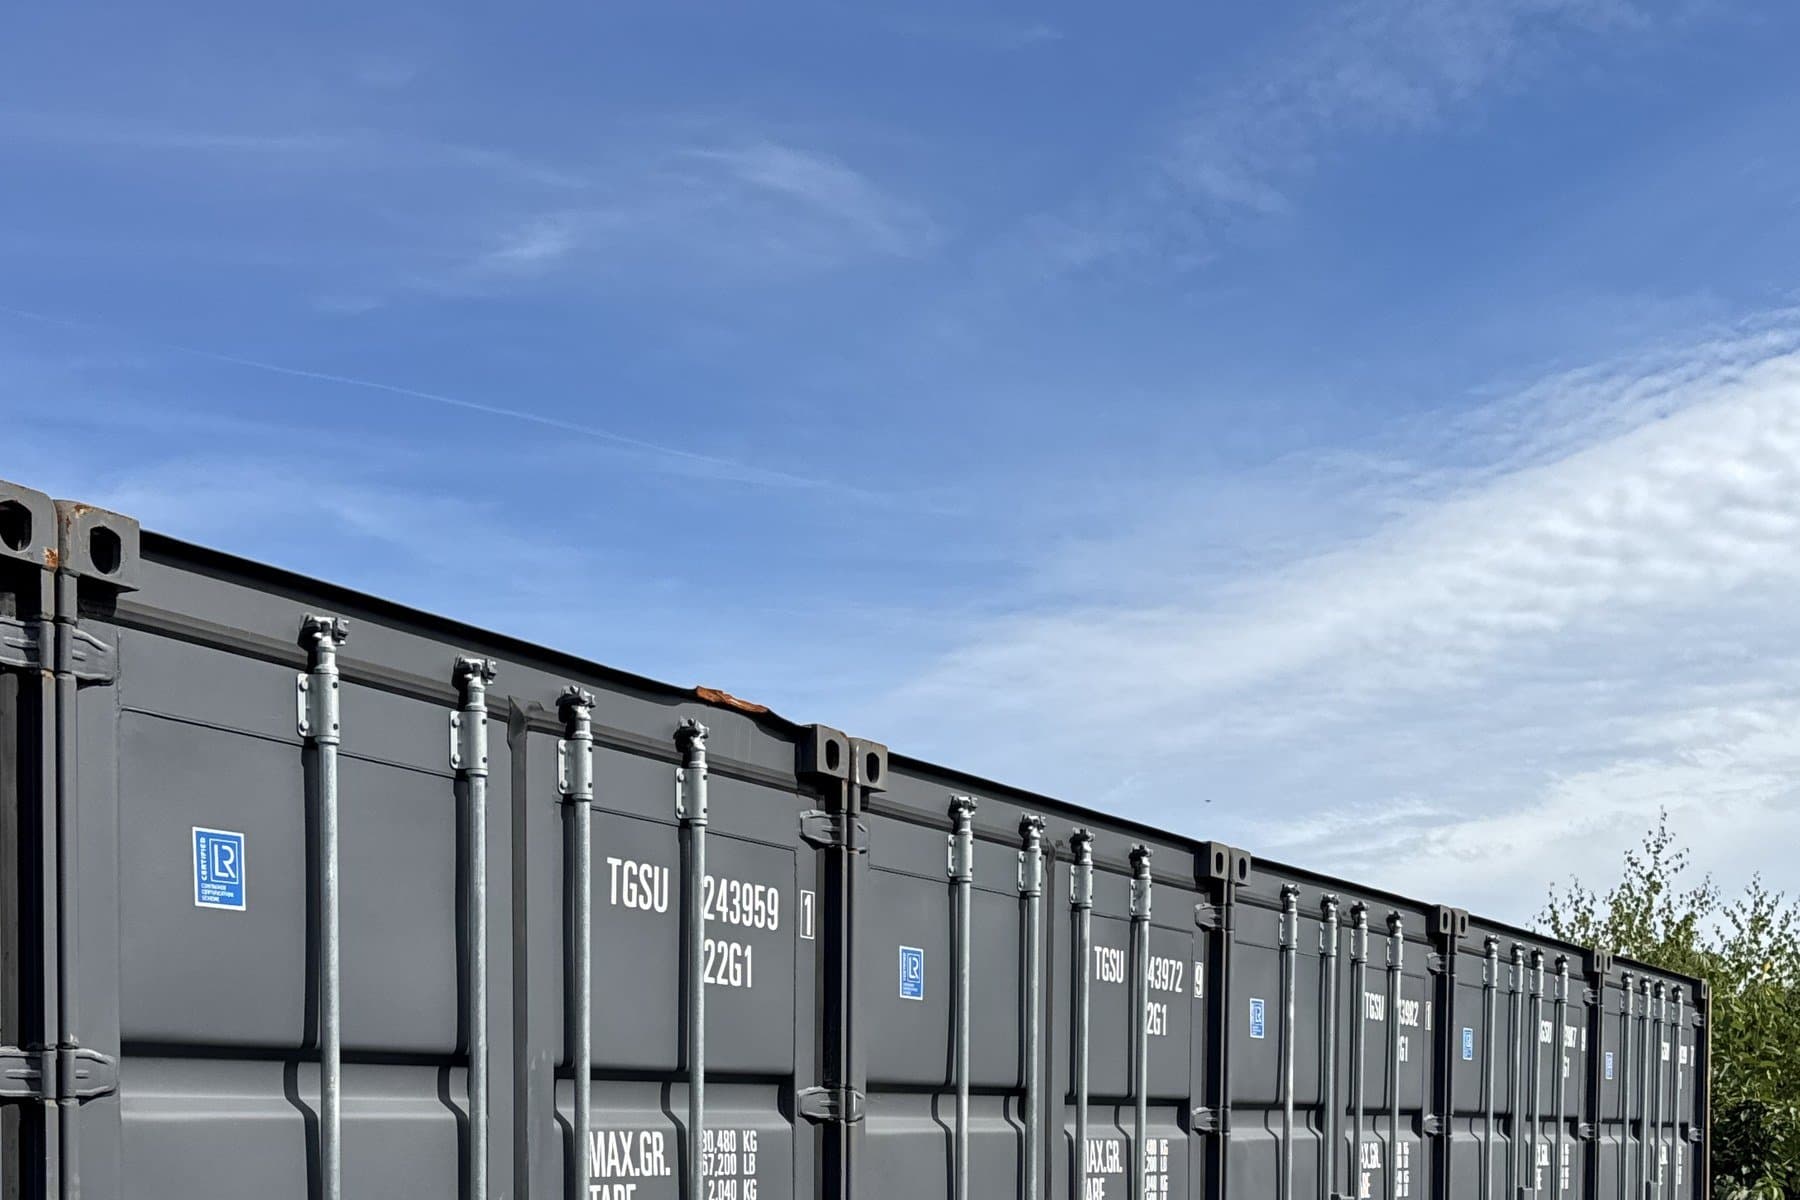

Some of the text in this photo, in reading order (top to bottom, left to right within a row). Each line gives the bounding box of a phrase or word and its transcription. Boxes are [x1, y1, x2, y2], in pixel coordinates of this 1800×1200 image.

[213, 844, 236, 878] LR
[606, 857, 813, 937] TGSU 243959 1
[703, 938, 752, 988] 22G1
[1094, 945, 1203, 997] TGSU 43972 9
[1147, 1002, 1167, 1036] 2G1
[1364, 991, 1385, 1022] TGSU
[1400, 1035, 1409, 1062] G1
[1541, 1020, 1553, 1044] GSU
[589, 1130, 757, 1177] MAX.GR. 30,480 KG
[702, 1153, 756, 1176] 67,200 LB
[743, 1179, 757, 1200] KG
